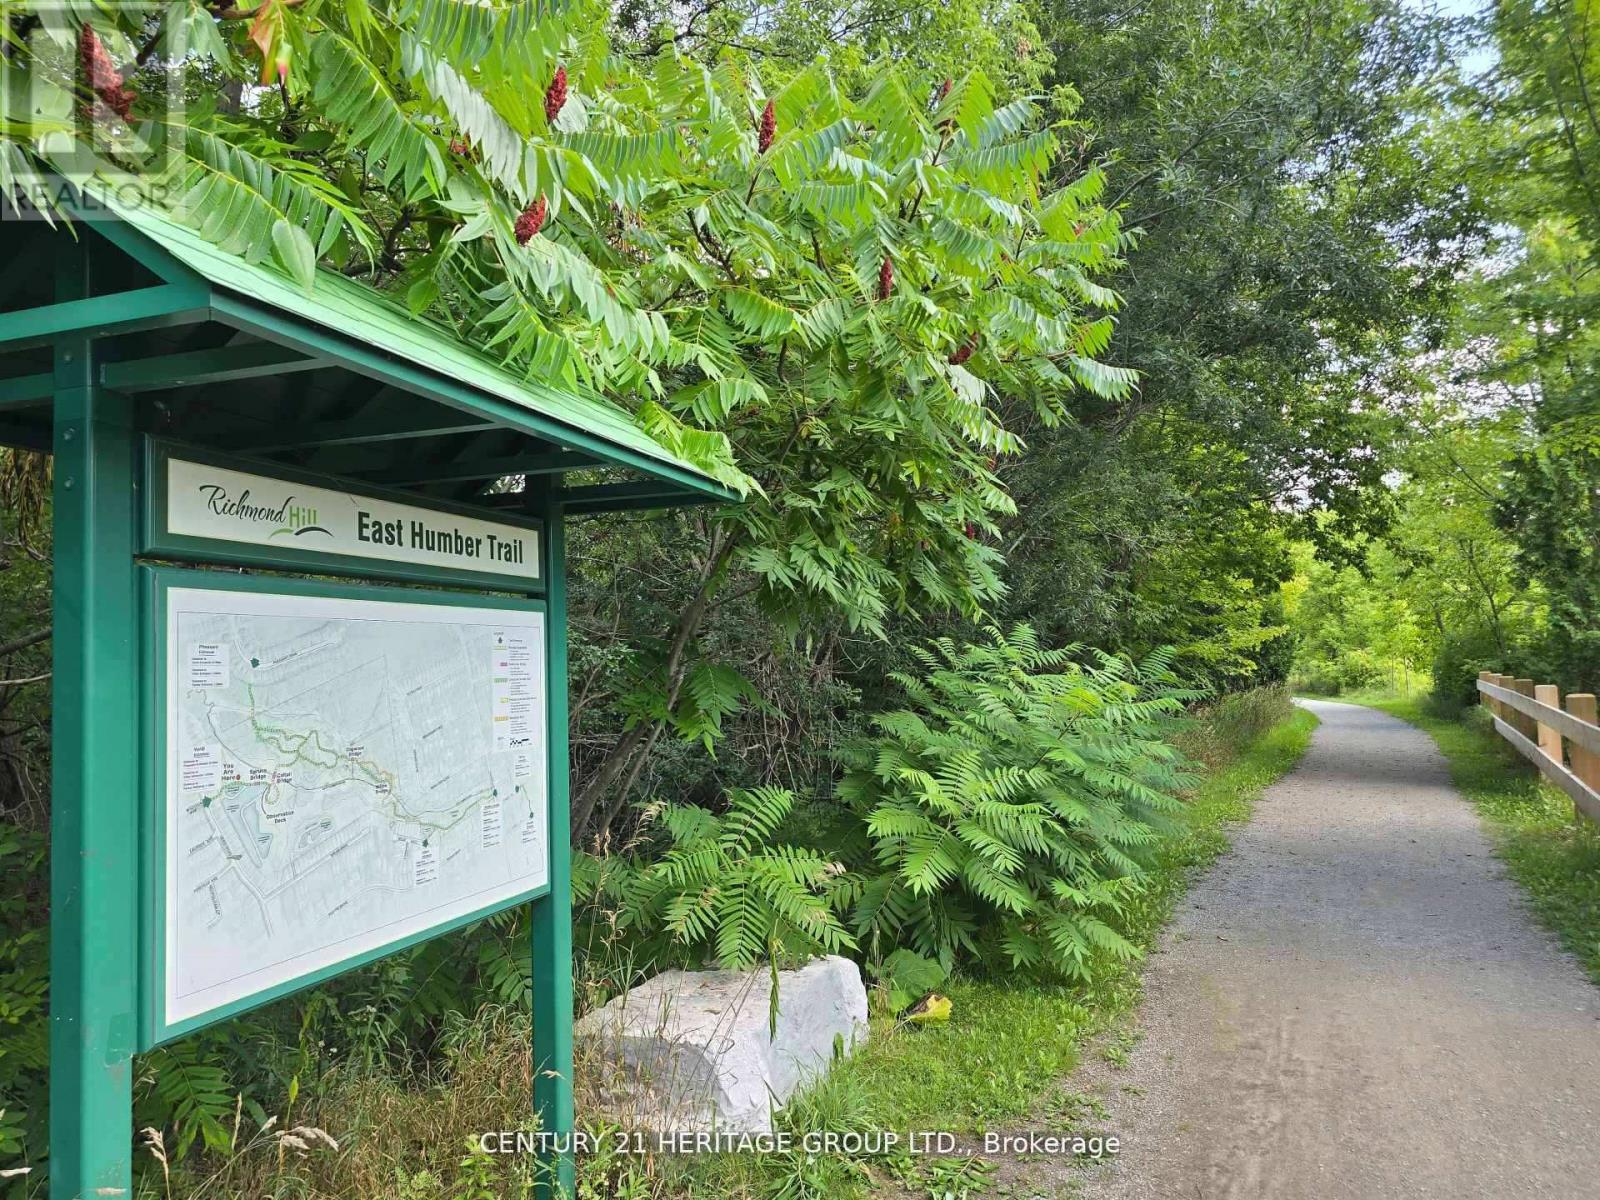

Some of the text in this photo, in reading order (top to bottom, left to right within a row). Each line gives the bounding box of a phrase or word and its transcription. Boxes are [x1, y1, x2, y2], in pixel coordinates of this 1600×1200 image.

[199, 485, 317, 527] Richmond Hill
[358, 511, 523, 563] East Humber Trail
